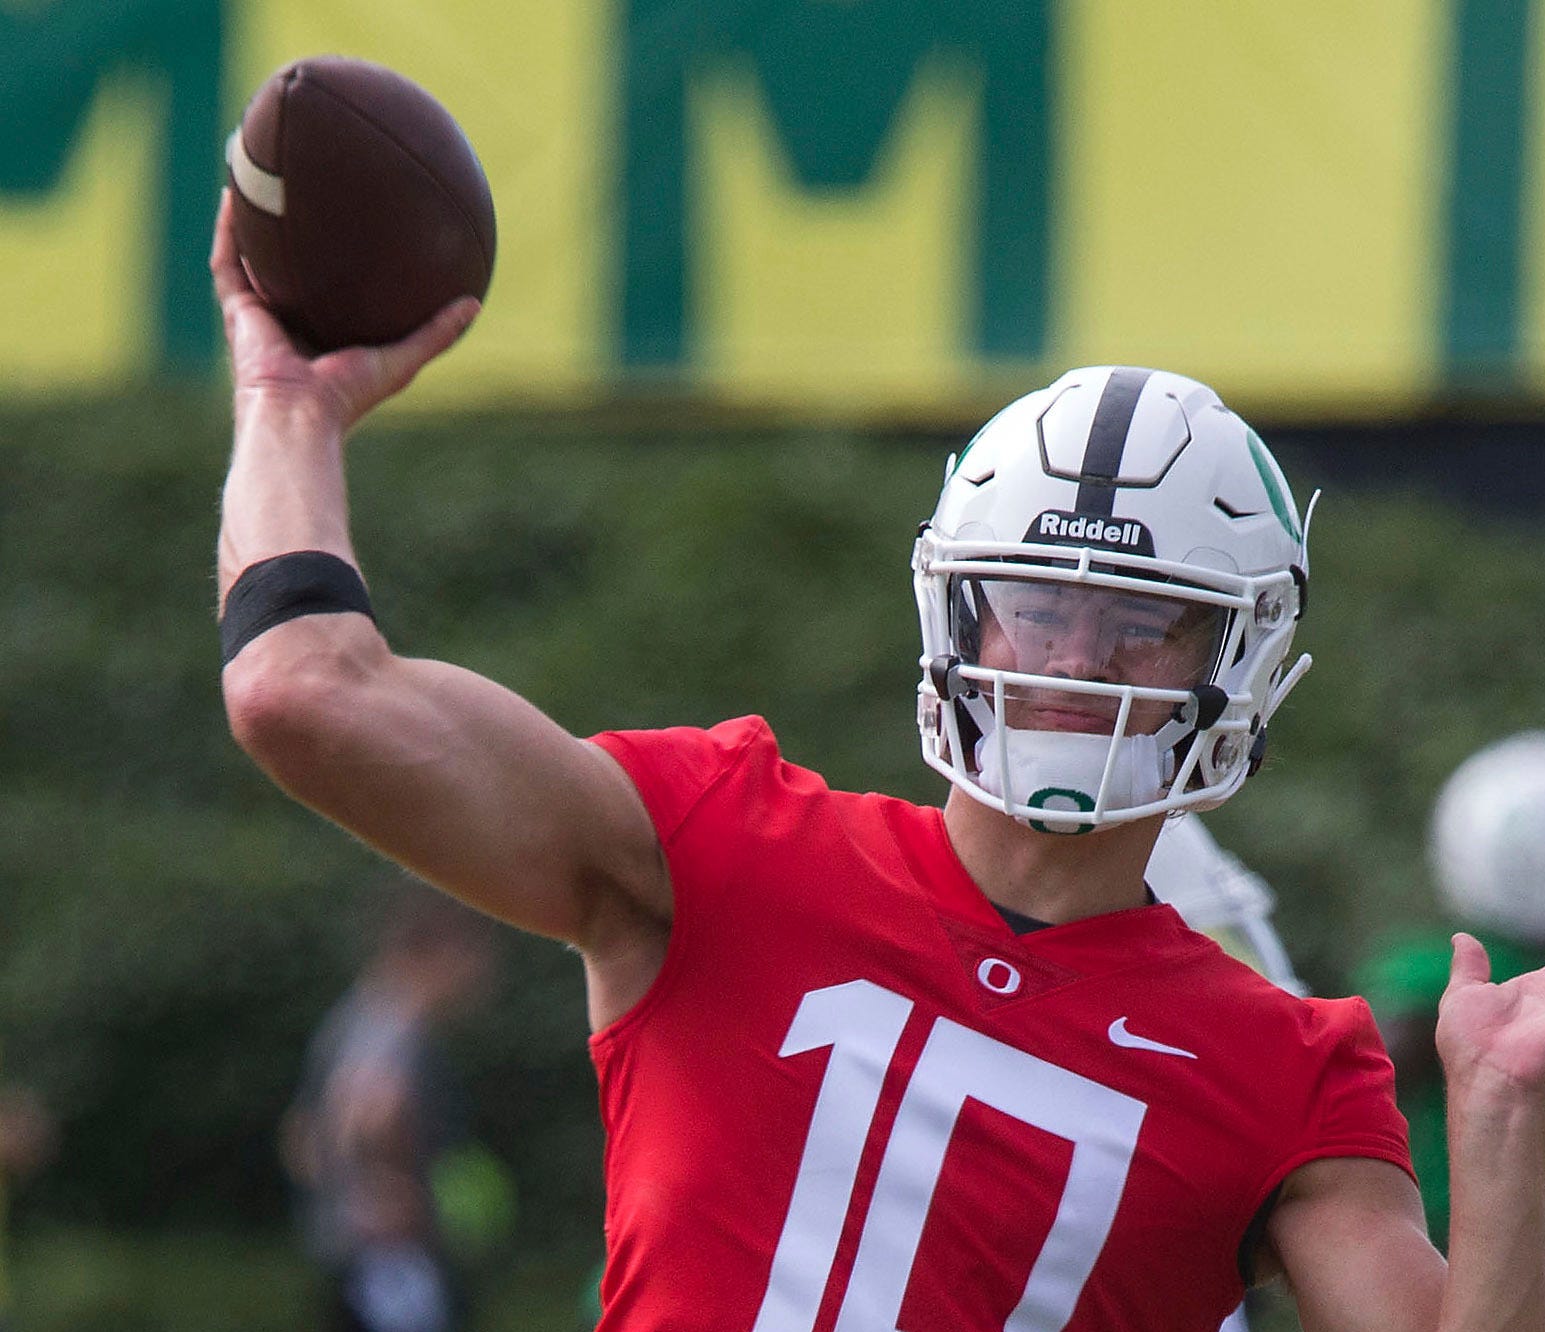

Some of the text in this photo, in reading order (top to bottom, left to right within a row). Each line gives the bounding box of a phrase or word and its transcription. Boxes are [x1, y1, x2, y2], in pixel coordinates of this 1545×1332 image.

[1039, 512, 1142, 546] Riddell
[1027, 786, 1097, 835] O
[977, 957, 1021, 994] O
